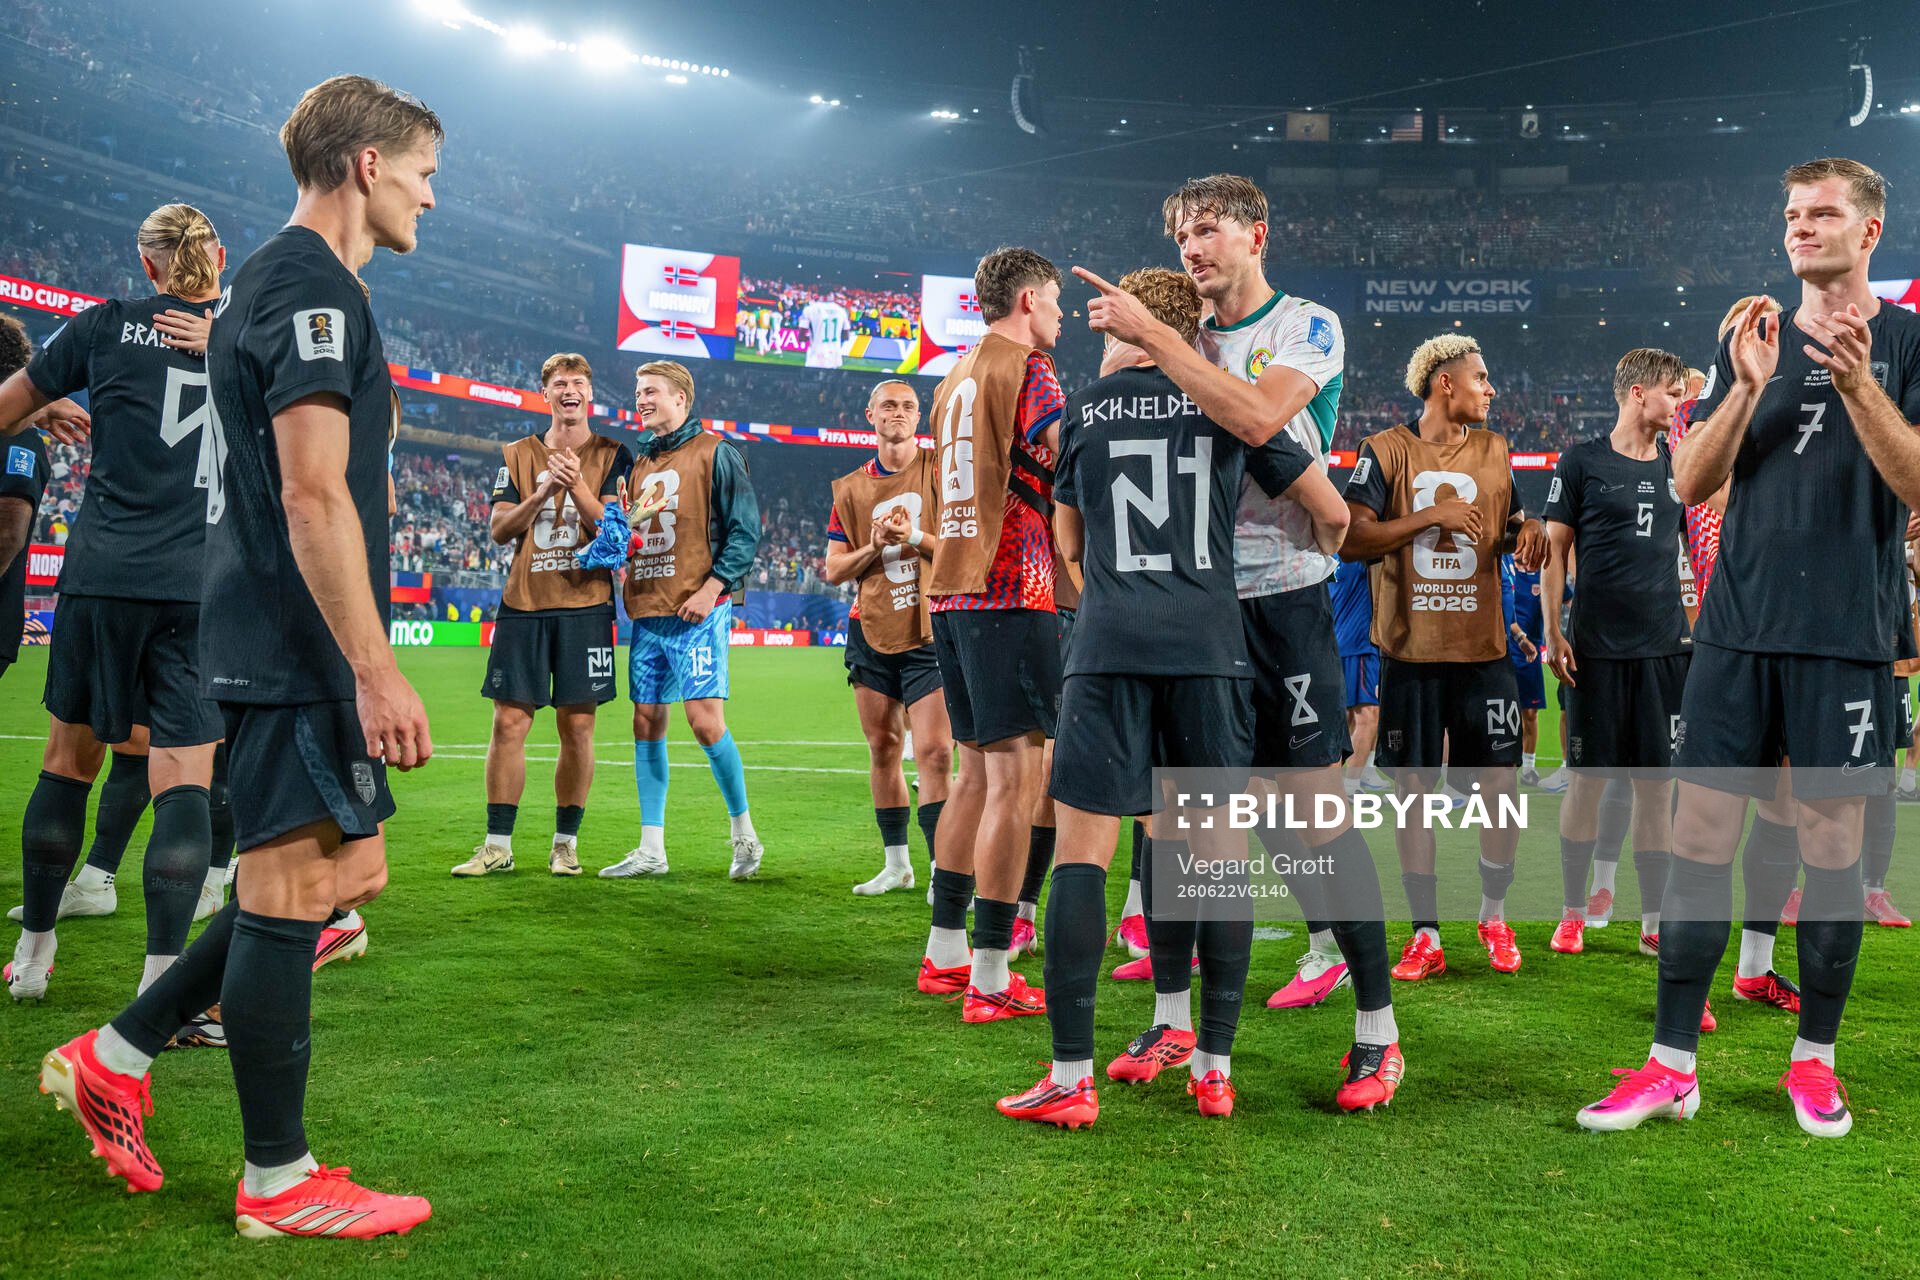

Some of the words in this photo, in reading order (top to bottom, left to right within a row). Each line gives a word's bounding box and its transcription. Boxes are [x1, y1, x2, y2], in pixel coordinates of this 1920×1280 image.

[0, 280, 33, 302] RLD
[35, 288, 69, 309] CUP
[1366, 280, 1437, 295] NEW
[1445, 280, 1532, 295] YORK
[649, 291, 710, 313] NORWAY
[1366, 300, 1424, 312] NEW
[1430, 300, 1532, 313] JERSEY
[822, 318, 838, 343] 11
[1081, 393, 1202, 428] SCHJELDE
[821, 430, 848, 444] FIFA
[850, 432, 877, 445] WOR
[1793, 402, 1826, 455] 7
[1108, 436, 1213, 572] 21
[939, 520, 978, 539] 026
[1636, 503, 1653, 537] 5
[549, 530, 569, 542] FIFA
[647, 537, 665, 547] FIFA
[532, 550, 564, 560] WORLD
[565, 549, 578, 558] CU
[634, 557, 659, 567] WORLD
[660, 555, 676, 564] CUP
[1432, 558, 1461, 569] FIFA
[30, 553, 64, 577] NOR
[530, 559, 580, 573] 2026
[634, 564, 676, 580] 2026
[901, 561, 919, 575] FIF
[890, 583, 919, 598] WORL
[1412, 583, 1454, 594] WORLD
[1456, 584, 1478, 594] CUP
[892, 592, 920, 611] 20
[1411, 595, 1478, 612] 2026
[390, 621, 434, 646] mco
[587, 647, 613, 678] 25
[688, 646, 713, 677] 12
[1284, 673, 1319, 727] 8
[1487, 698, 1520, 737] 20
[1844, 699, 1875, 758] 7
